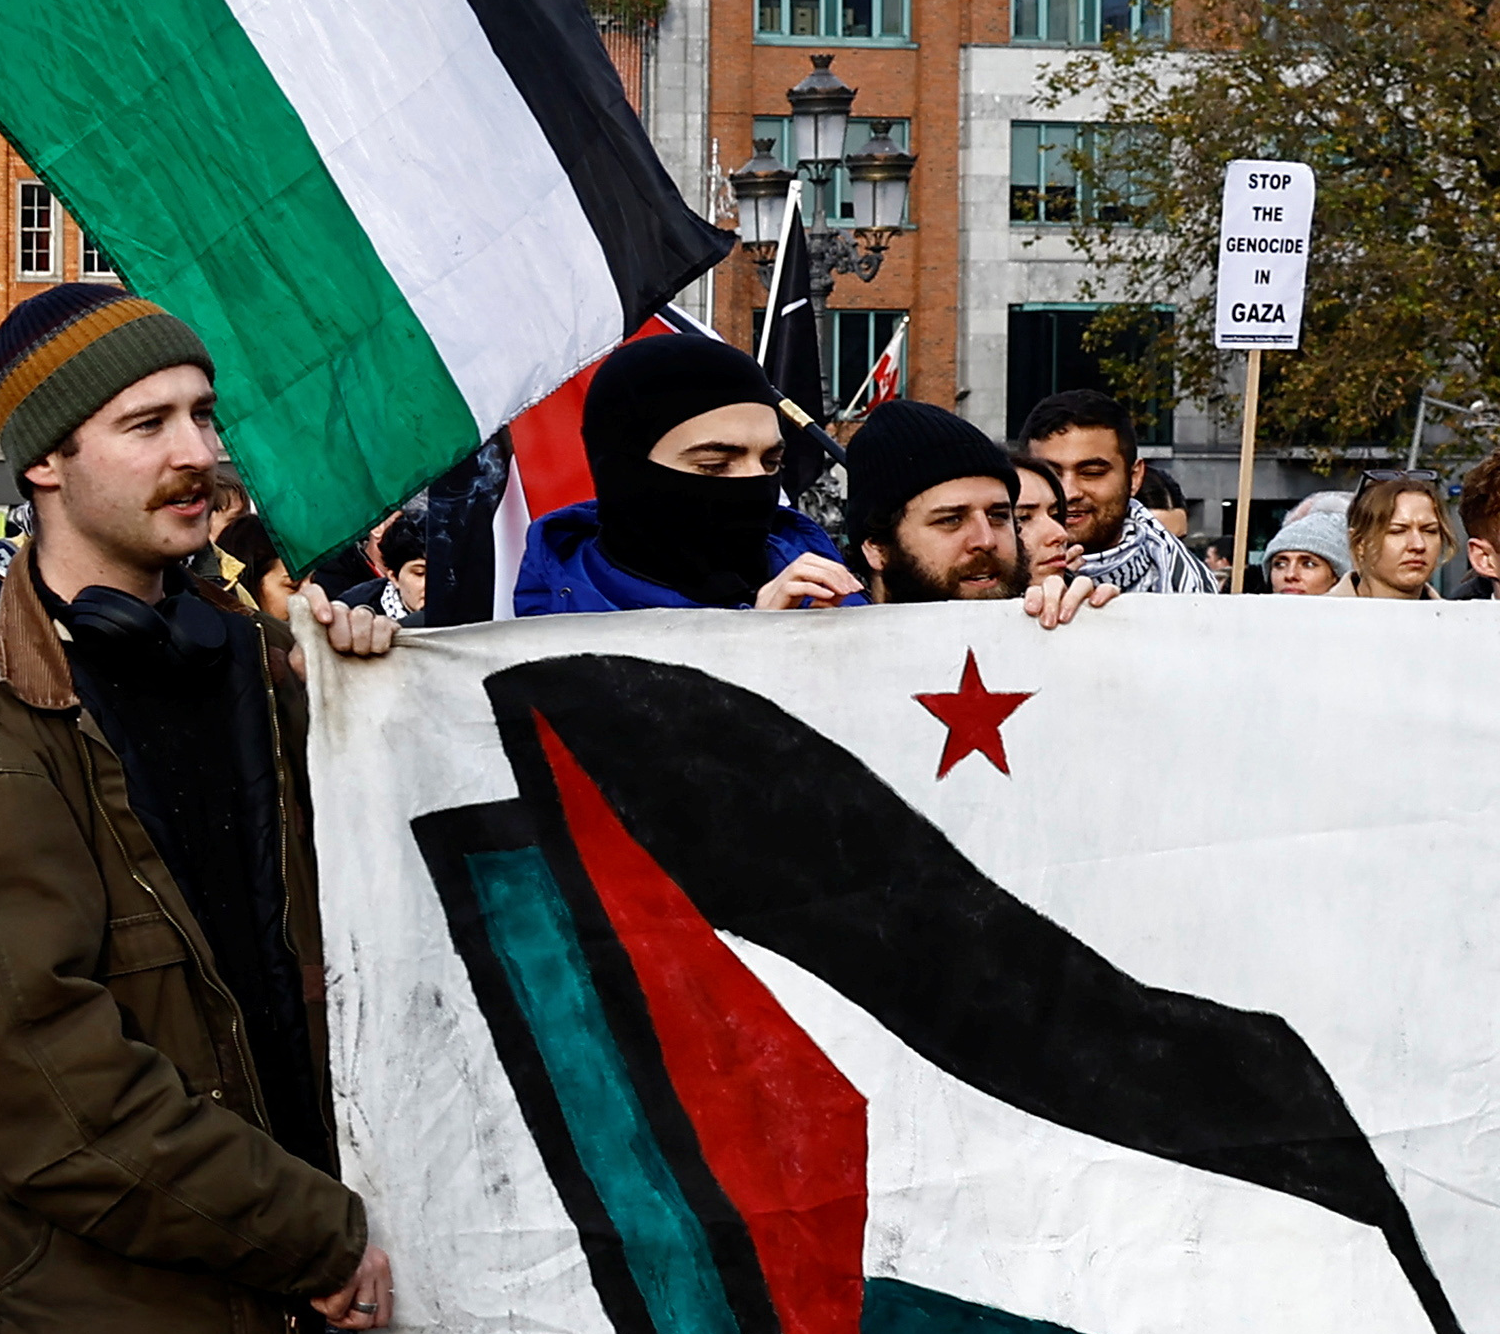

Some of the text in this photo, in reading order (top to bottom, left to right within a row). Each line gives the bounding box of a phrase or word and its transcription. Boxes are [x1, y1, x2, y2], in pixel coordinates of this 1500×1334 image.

[1248, 173, 1291, 190] STOP
[1253, 206, 1283, 222] THE
[1226, 237, 1303, 253] GENOCIDE
[1254, 269, 1271, 285] IN
[1231, 303, 1286, 323] GAZA
